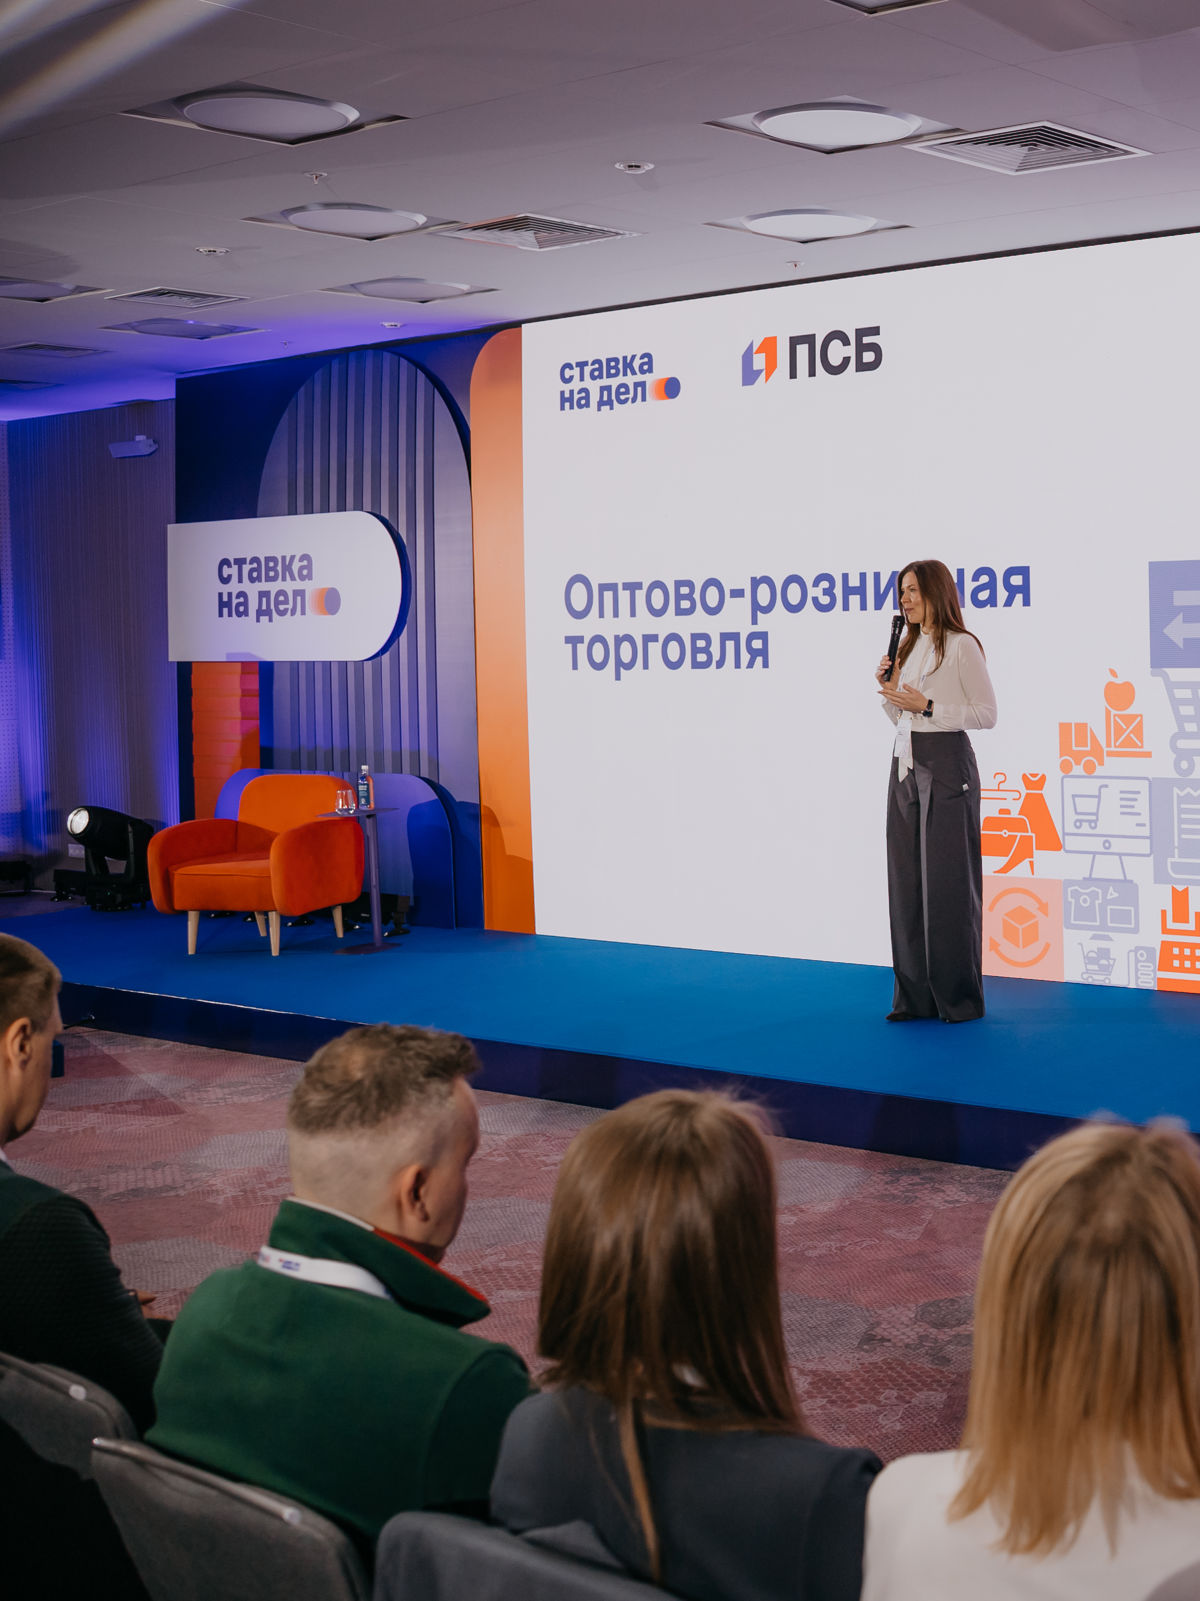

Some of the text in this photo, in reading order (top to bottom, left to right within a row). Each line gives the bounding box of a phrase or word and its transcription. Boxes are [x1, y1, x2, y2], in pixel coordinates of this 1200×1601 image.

[559, 352, 654, 385] ставка
[788, 326, 884, 380] ПСБ
[559, 387, 591, 411] на
[217, 553, 313, 585] ставка
[217, 590, 249, 618] на
[564, 565, 1032, 625] Оптово-розниая
[564, 631, 770, 681] торговля
